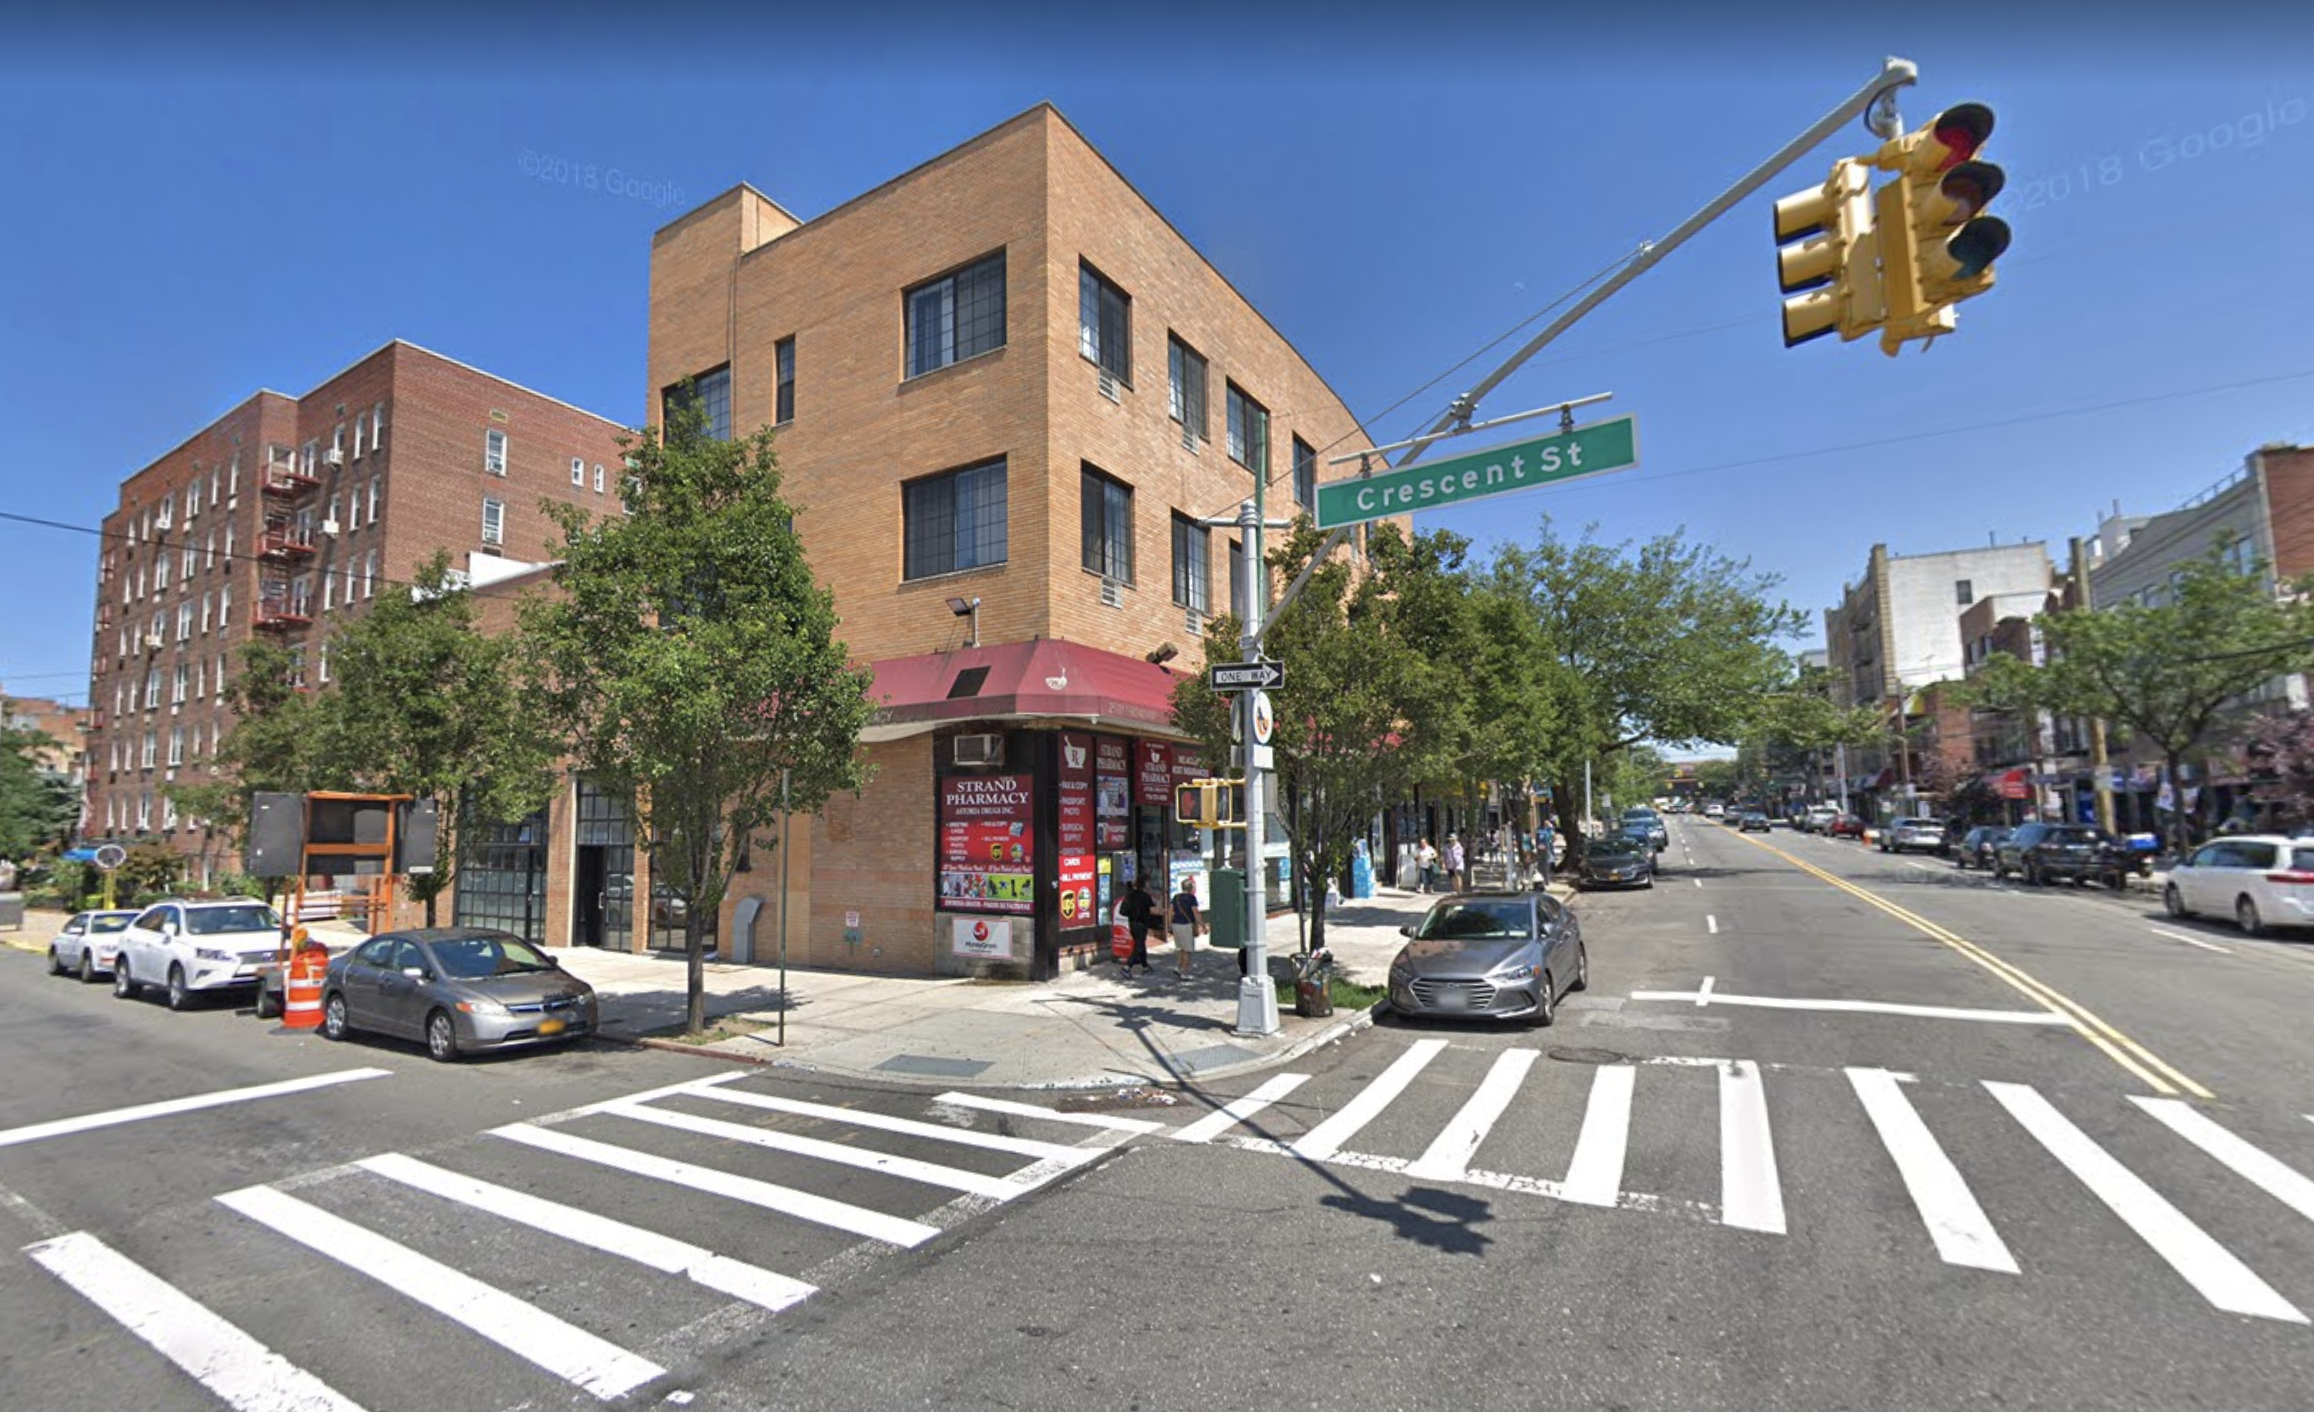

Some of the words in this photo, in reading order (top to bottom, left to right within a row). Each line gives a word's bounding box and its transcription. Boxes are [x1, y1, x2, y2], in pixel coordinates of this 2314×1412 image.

[1356, 454, 1526, 511] Crescent
[1540, 441, 1583, 473] St
[1221, 671, 1242, 682] ONE
[1250, 670, 1272, 681] WAY
[1141, 771, 1171, 784] PHARMACY
[957, 780, 1017, 793] STRAND
[946, 792, 1029, 805] PHARMACY
[1002, 806, 1015, 815] INC.
